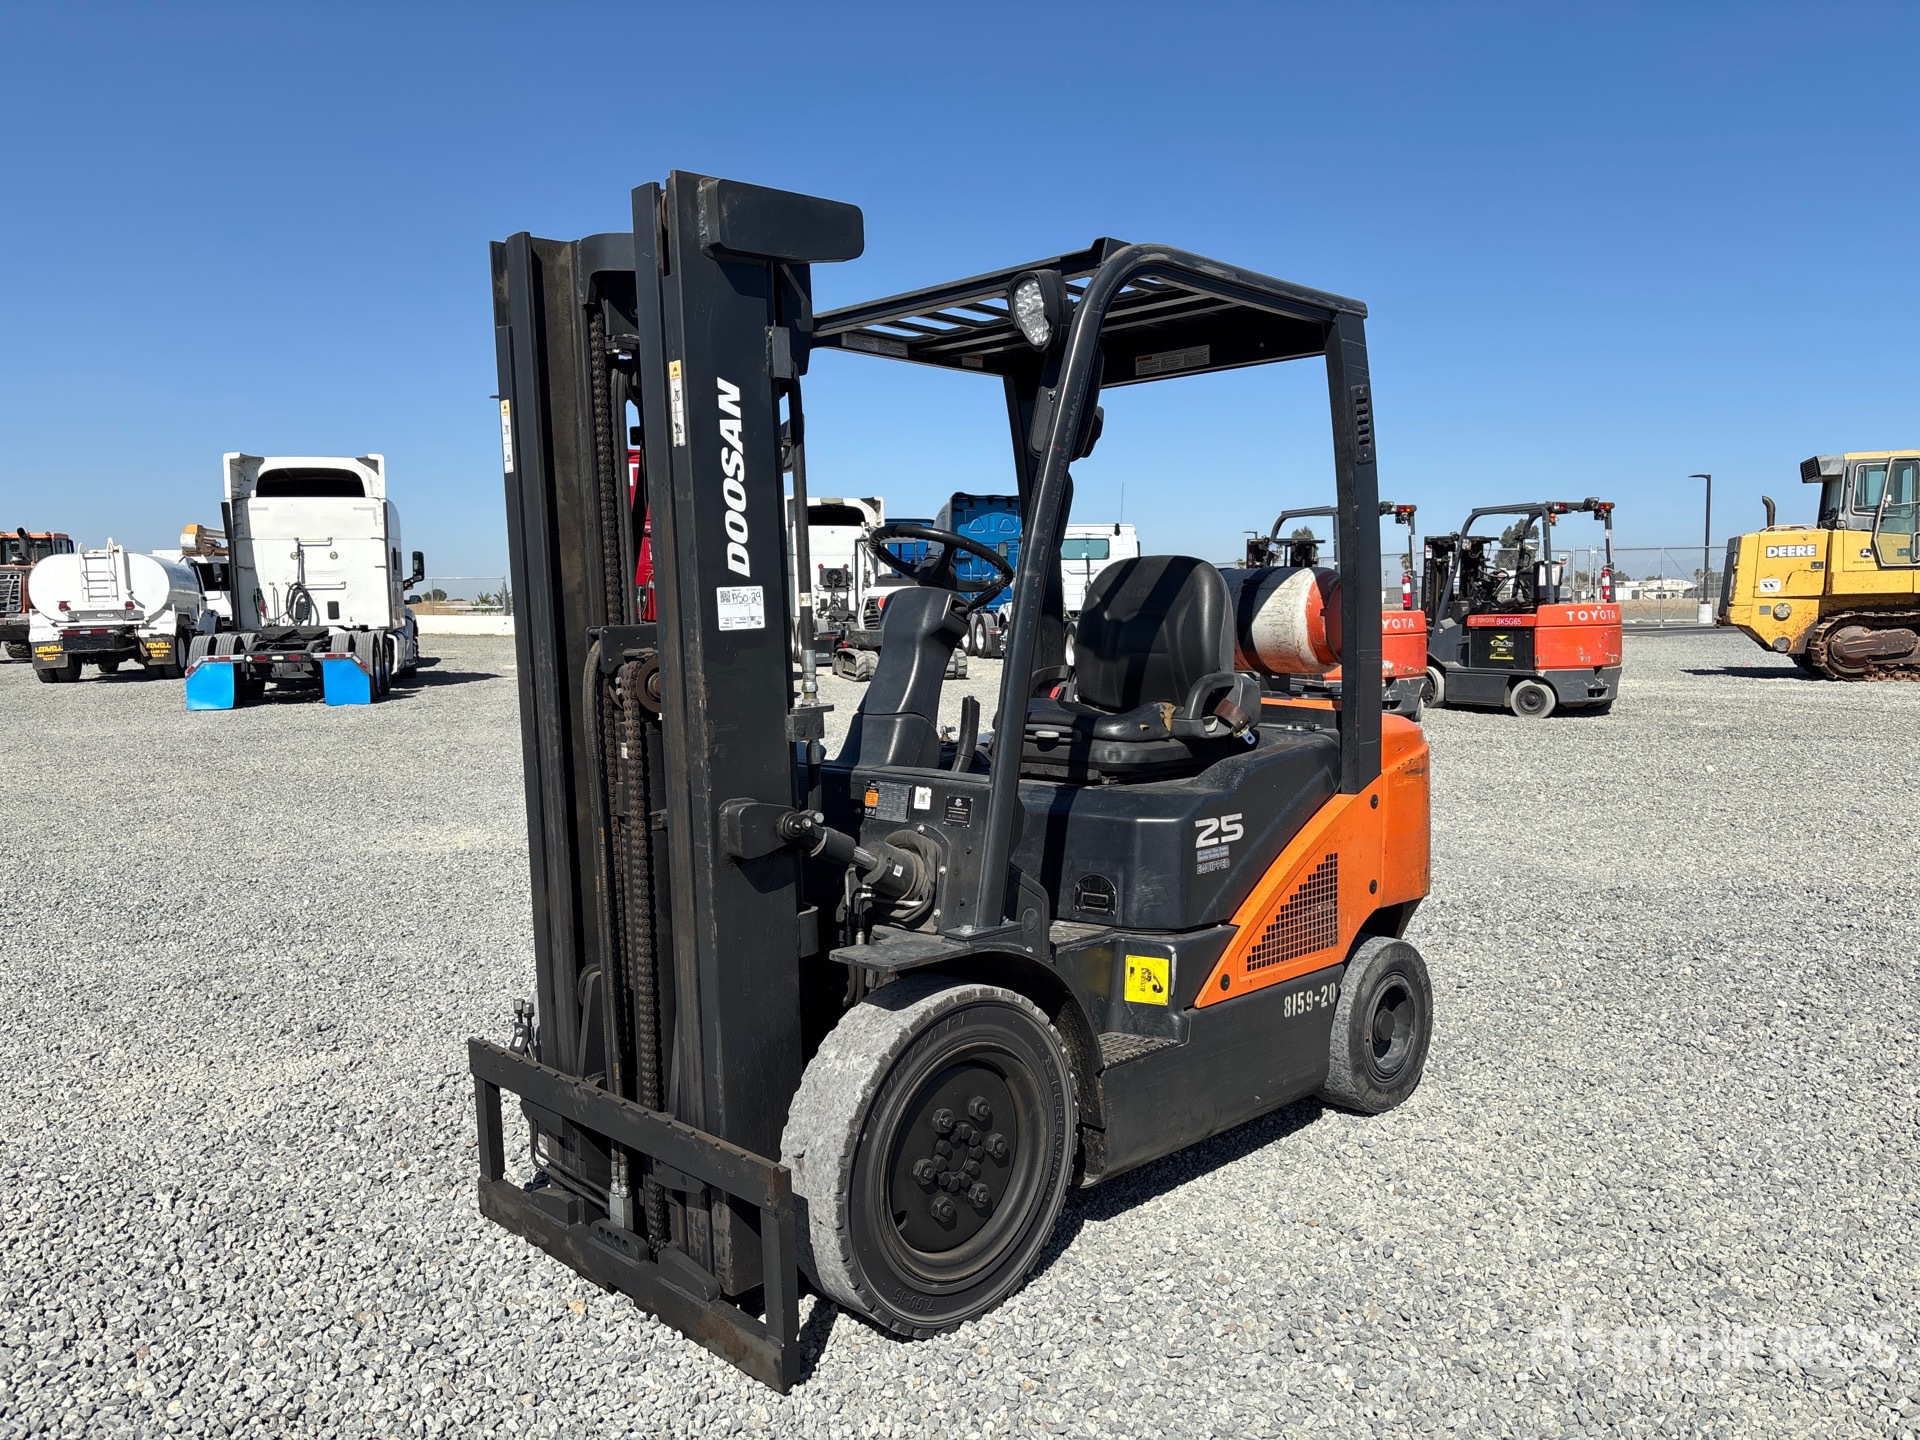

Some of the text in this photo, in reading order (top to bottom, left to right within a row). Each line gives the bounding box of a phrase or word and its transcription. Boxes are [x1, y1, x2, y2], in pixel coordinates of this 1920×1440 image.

[717, 377, 750, 578] DOOSAN
[1766, 544, 1816, 558] DEERE
[1382, 617, 1415, 629] YOTA
[1566, 610, 1616, 621] TOYOTA
[35, 645, 63, 653] LEDWELL
[1195, 813, 1244, 849] 25
[1197, 858, 1231, 875] EQUIPPED
[1284, 982, 1336, 1018] 8159-20
